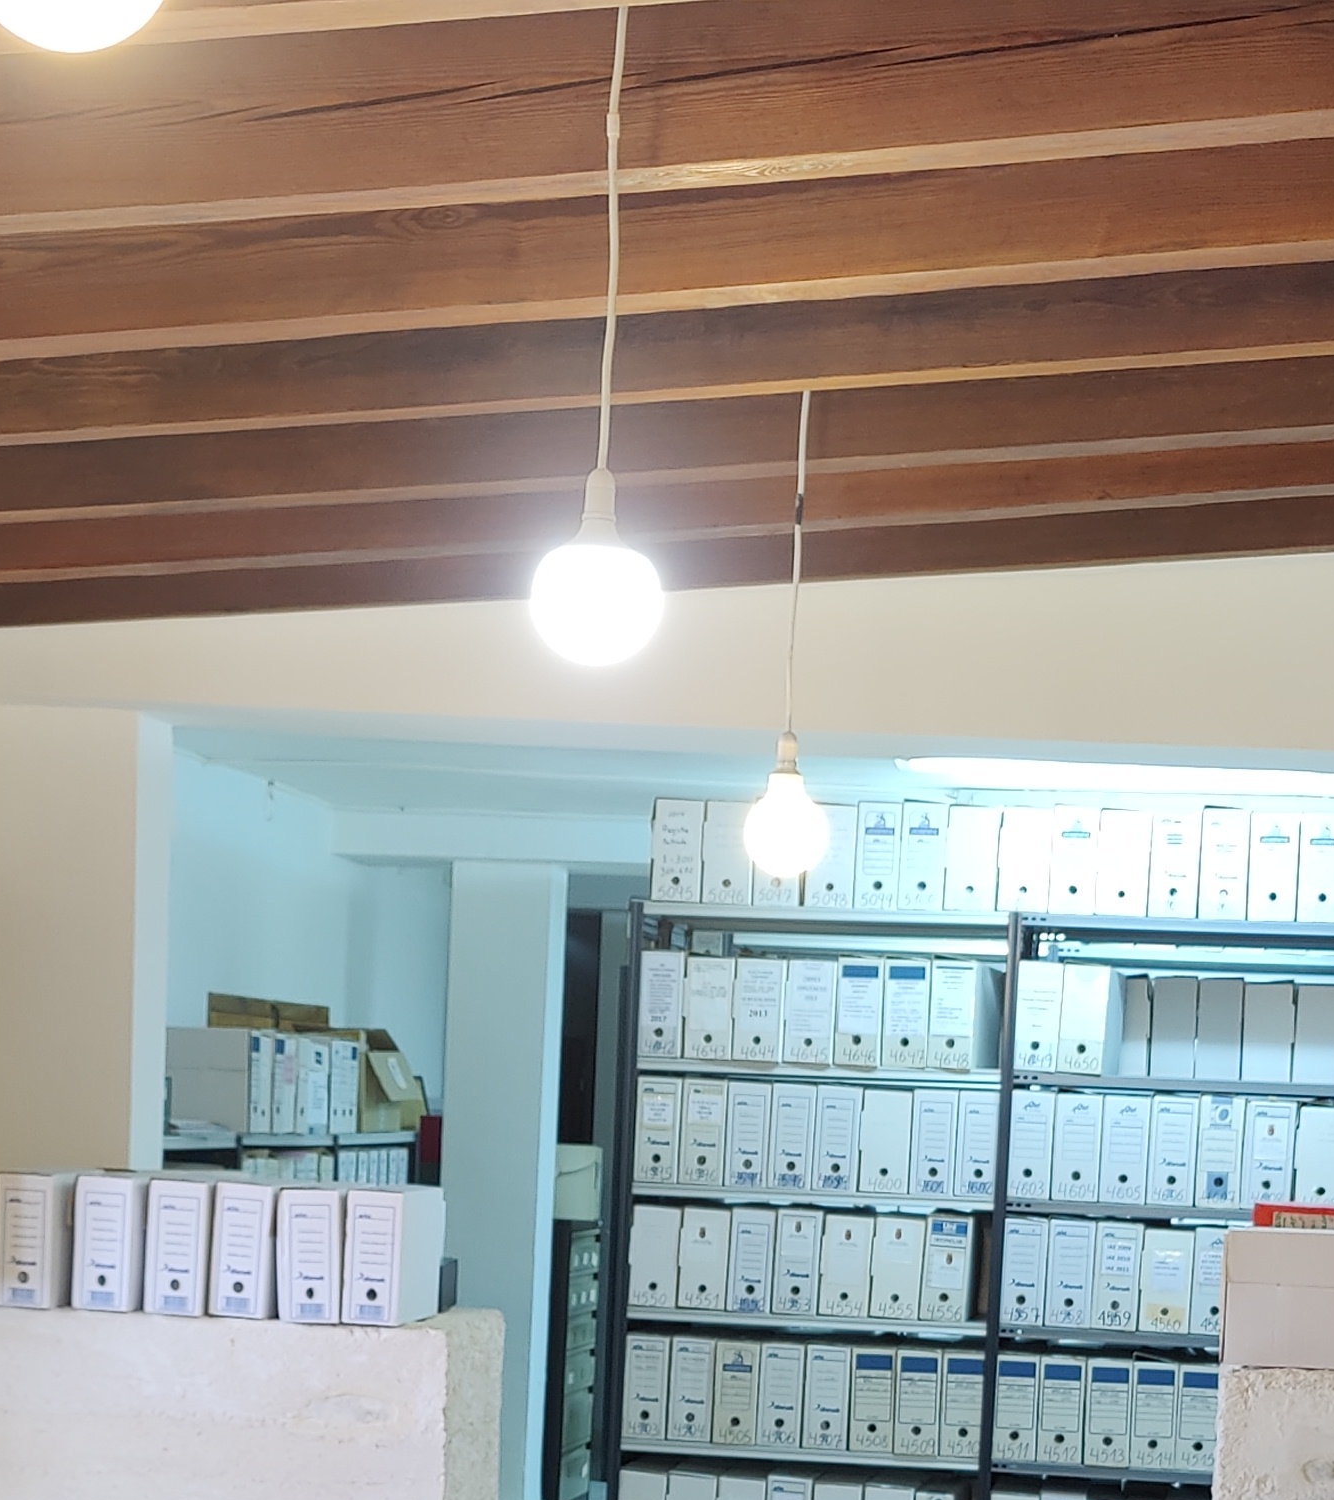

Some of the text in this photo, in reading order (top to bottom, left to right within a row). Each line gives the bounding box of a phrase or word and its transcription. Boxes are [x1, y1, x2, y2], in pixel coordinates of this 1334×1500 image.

[692, 1043, 726, 1058] 4643
[741, 1045, 775, 1059] 4644
[790, 1046, 828, 1061] 4645
[843, 1048, 876, 1063] 4646
[890, 1049, 925, 1064] 4647
[935, 1051, 970, 1067] 4648
[1065, 1054, 1098, 1070] 4650
[868, 1177, 902, 1191] 4600
[1010, 1182, 1045, 1196] 4603
[1058, 1182, 1095, 1199] 4604
[1106, 1185, 1141, 1200] 4605
[685, 1292, 719, 1307] 4551
[826, 1301, 863, 1315] 4554
[879, 1302, 914, 1317] 4555
[927, 1303, 962, 1321] 4556
[1151, 1317, 1181, 1331] 4560
[901, 1438, 935, 1454] 4509
[997, 1442, 1030, 1459] 4511
[1043, 1446, 1077, 1462] 4512
[1090, 1447, 1126, 1463] 4513
[1136, 1451, 1173, 1466] 4514
[1181, 1452, 1215, 1467] 4515
